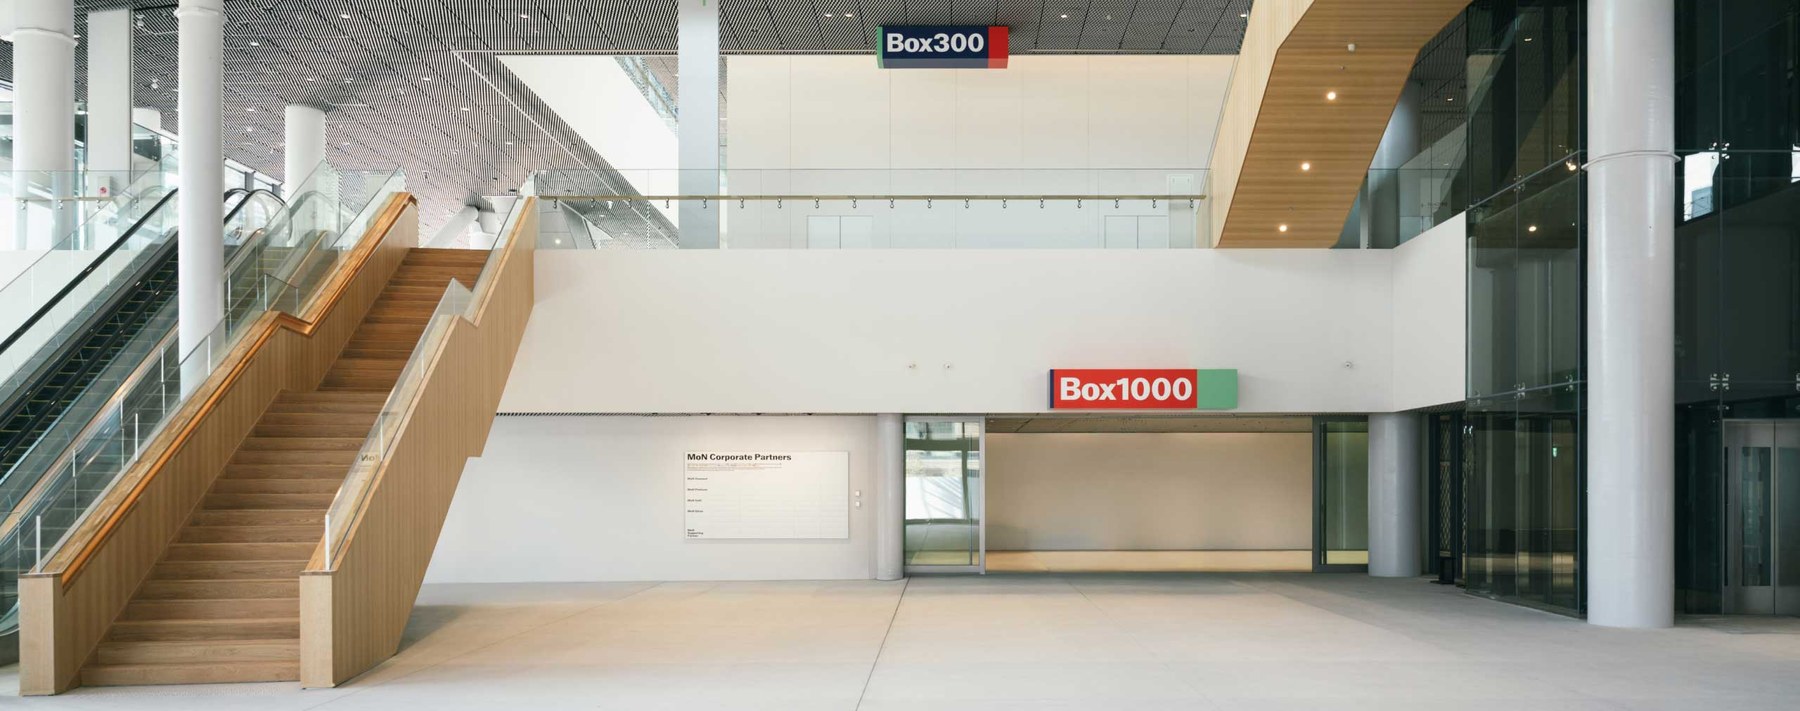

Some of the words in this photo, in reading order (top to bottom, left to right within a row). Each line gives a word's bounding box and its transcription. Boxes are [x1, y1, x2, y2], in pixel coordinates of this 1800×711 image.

[886, 33, 985, 53] Box300
[1060, 377, 1193, 401] Box1000
[687, 453, 708, 461] MoN
[709, 453, 753, 462] Corporate
[754, 453, 792, 461] Partners
